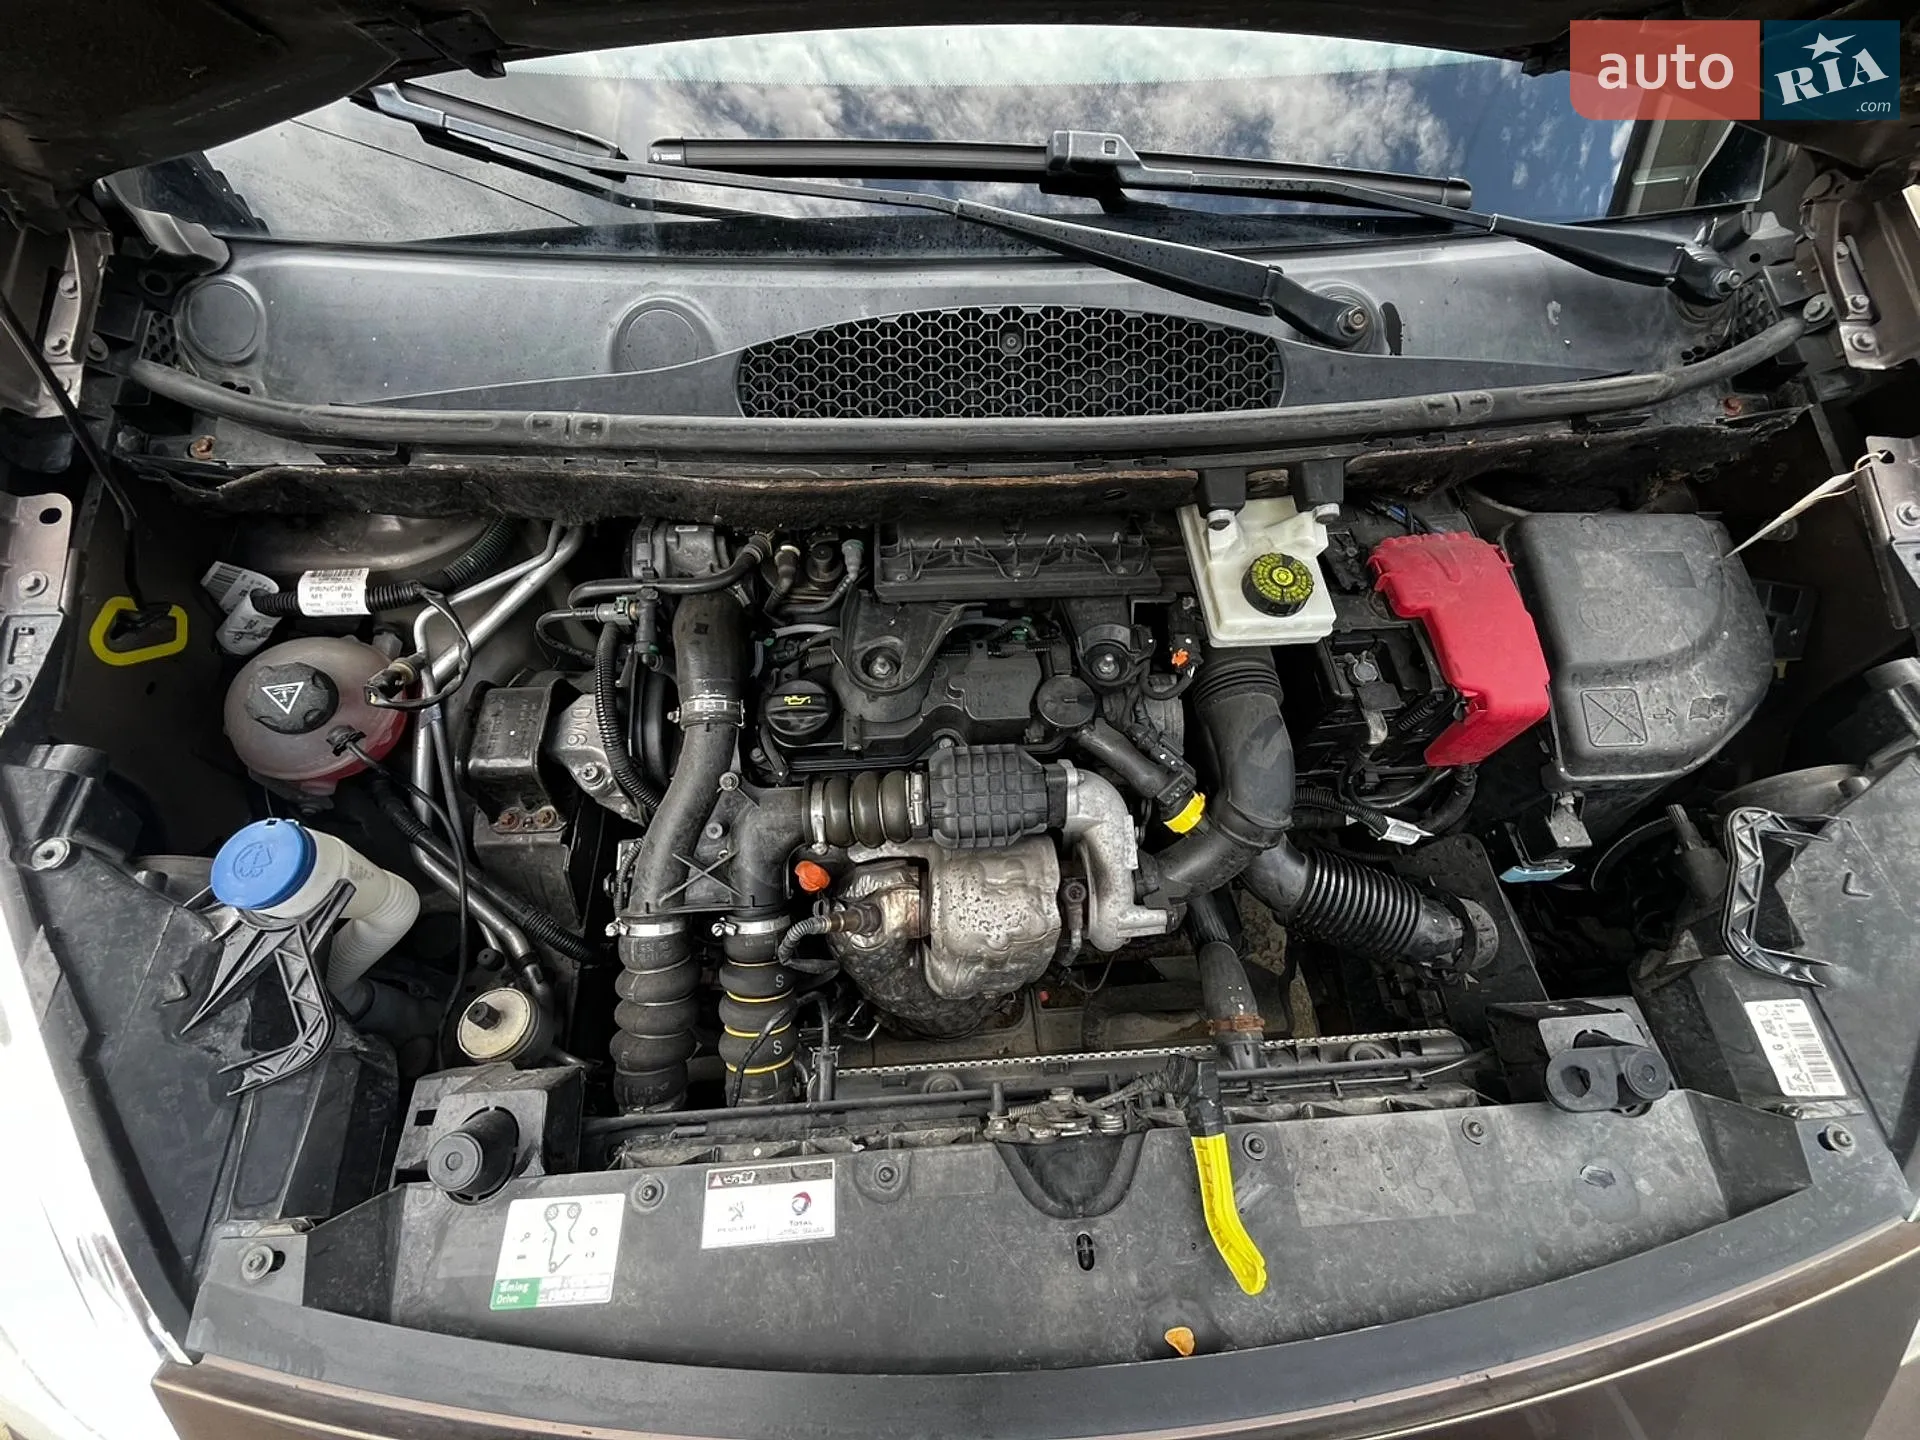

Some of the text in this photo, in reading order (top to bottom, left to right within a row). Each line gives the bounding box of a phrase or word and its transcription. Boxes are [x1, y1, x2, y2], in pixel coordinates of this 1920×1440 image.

[309, 584, 355, 593] PRINCIPAL
[775, 974, 785, 988] S
[773, 1040, 783, 1055] S
[789, 1219, 813, 1227] TOTAL
[496, 1294, 519, 1305] Drive
